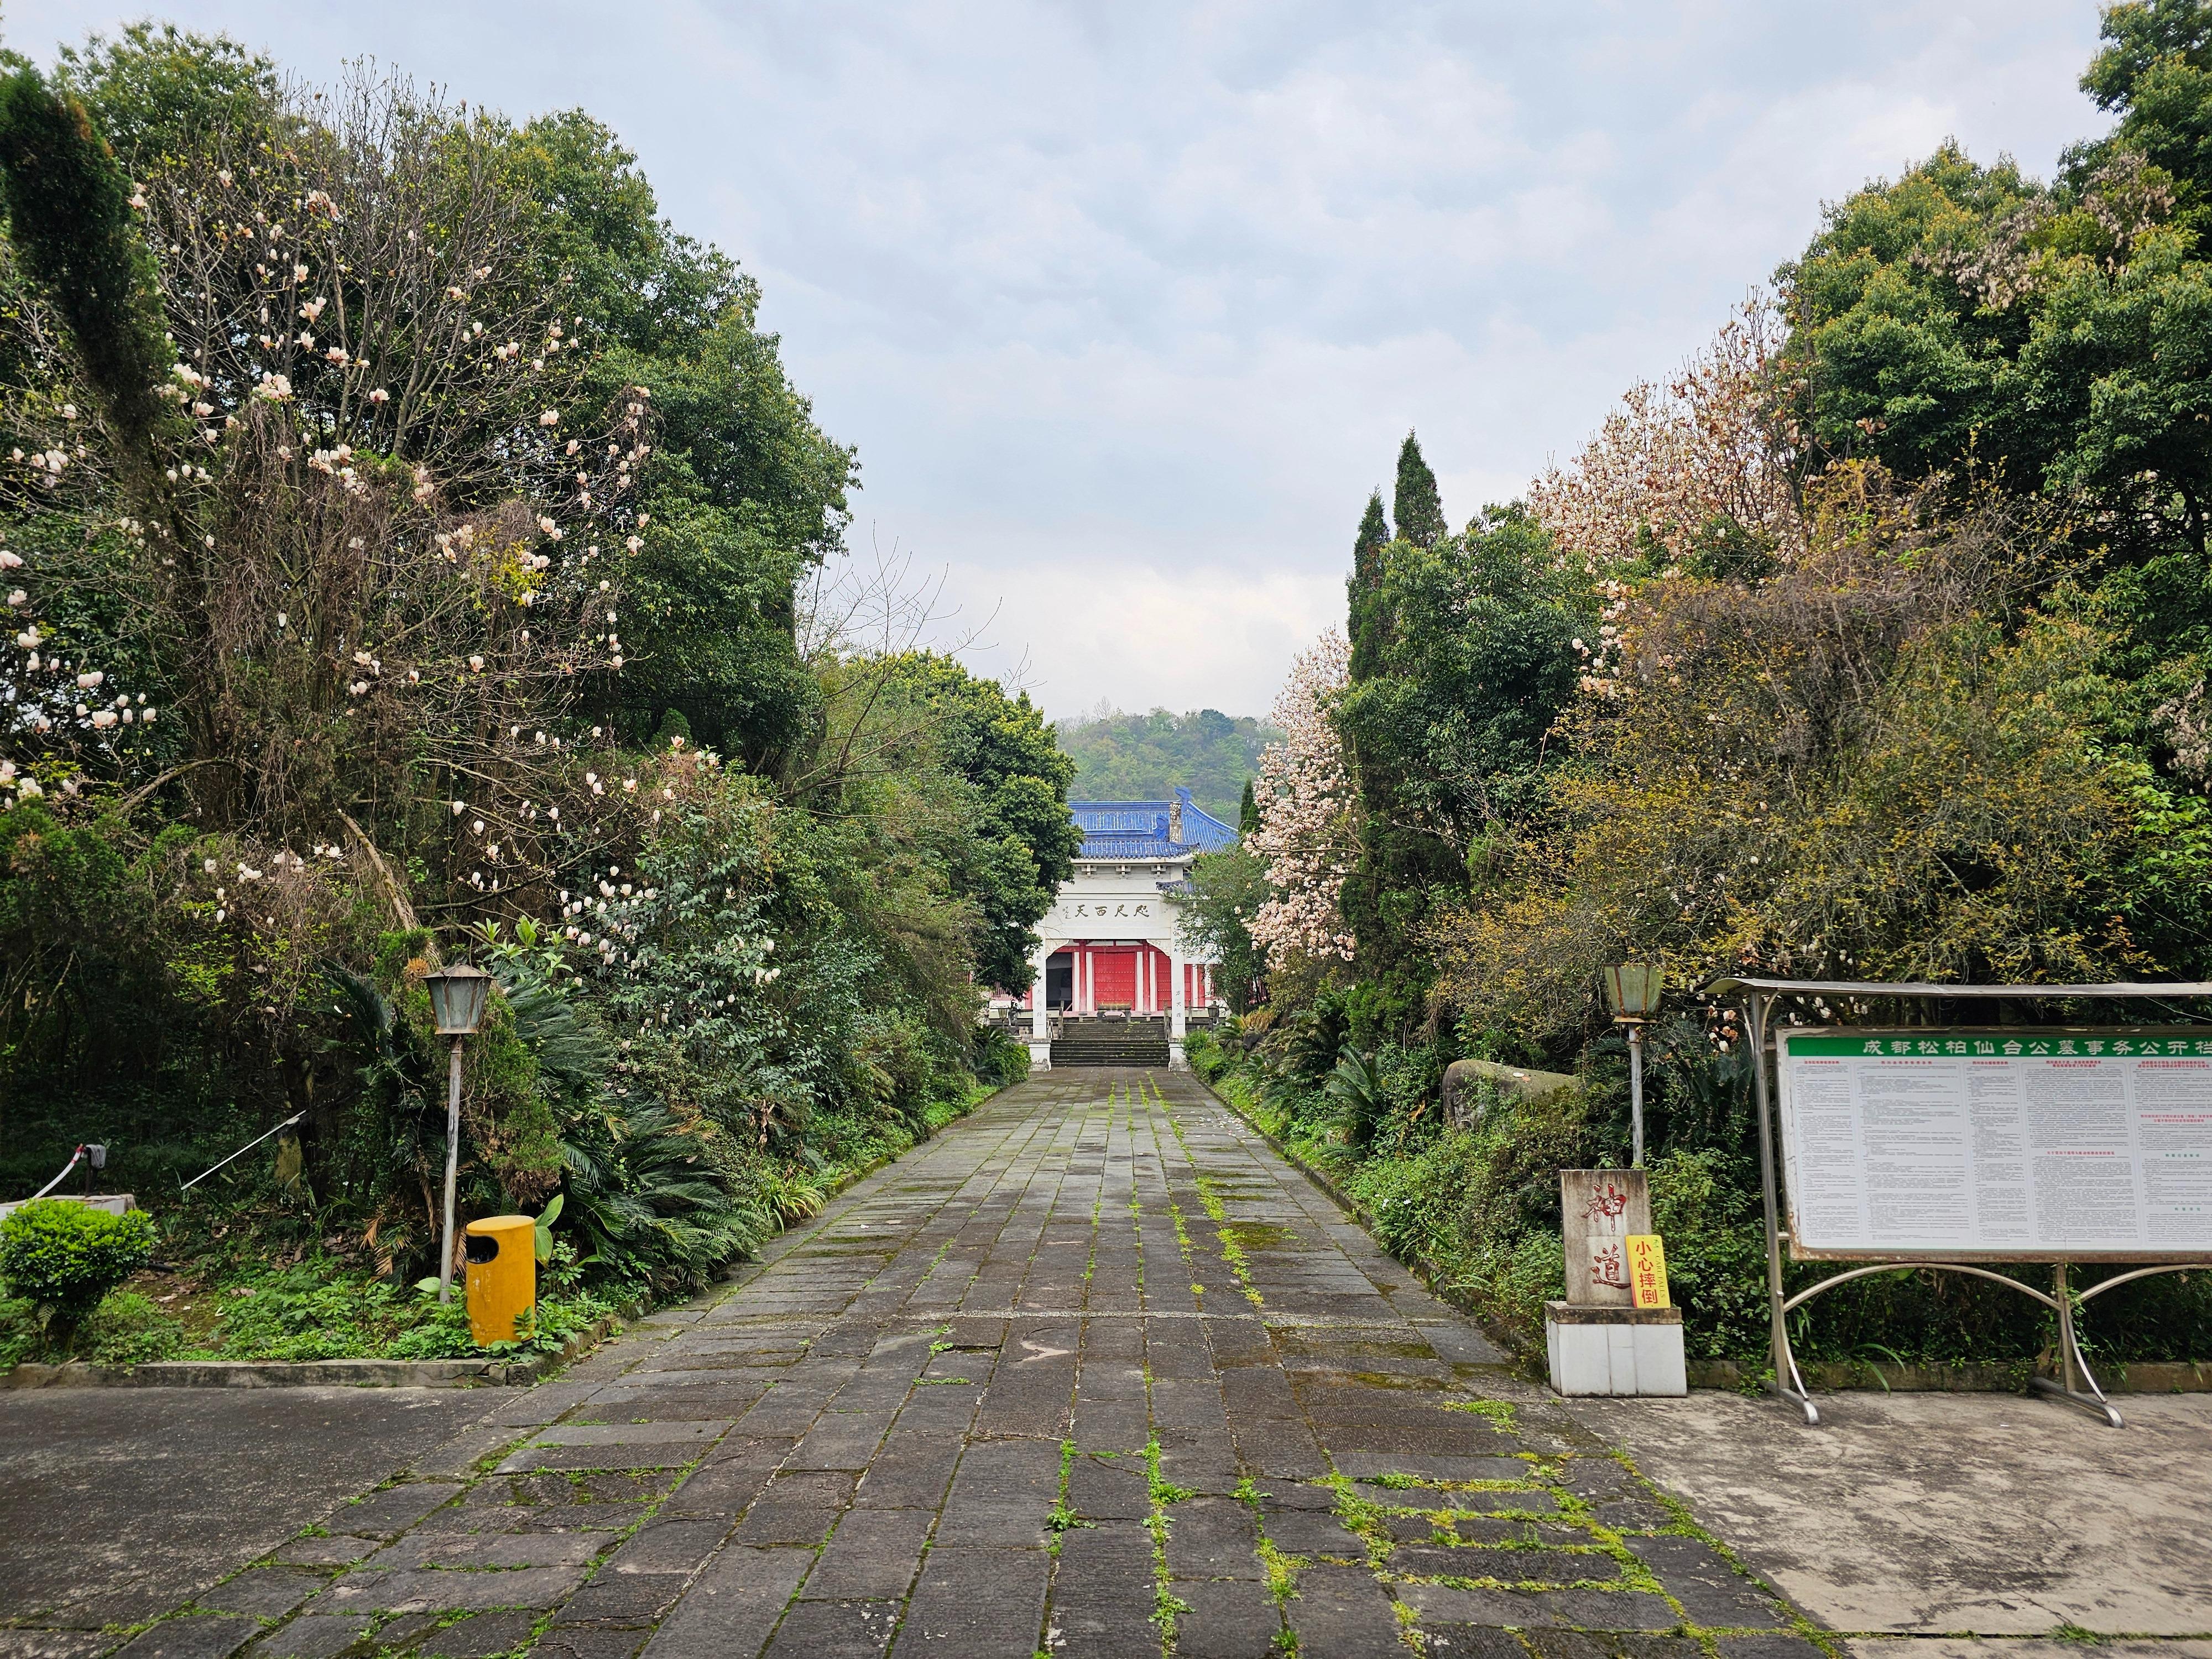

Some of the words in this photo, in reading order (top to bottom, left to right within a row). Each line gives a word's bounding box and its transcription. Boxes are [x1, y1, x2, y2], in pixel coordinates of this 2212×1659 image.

[1581, 1183, 1631, 1290] 神道
[1636, 1241, 1658, 1304] 小心摔倒
